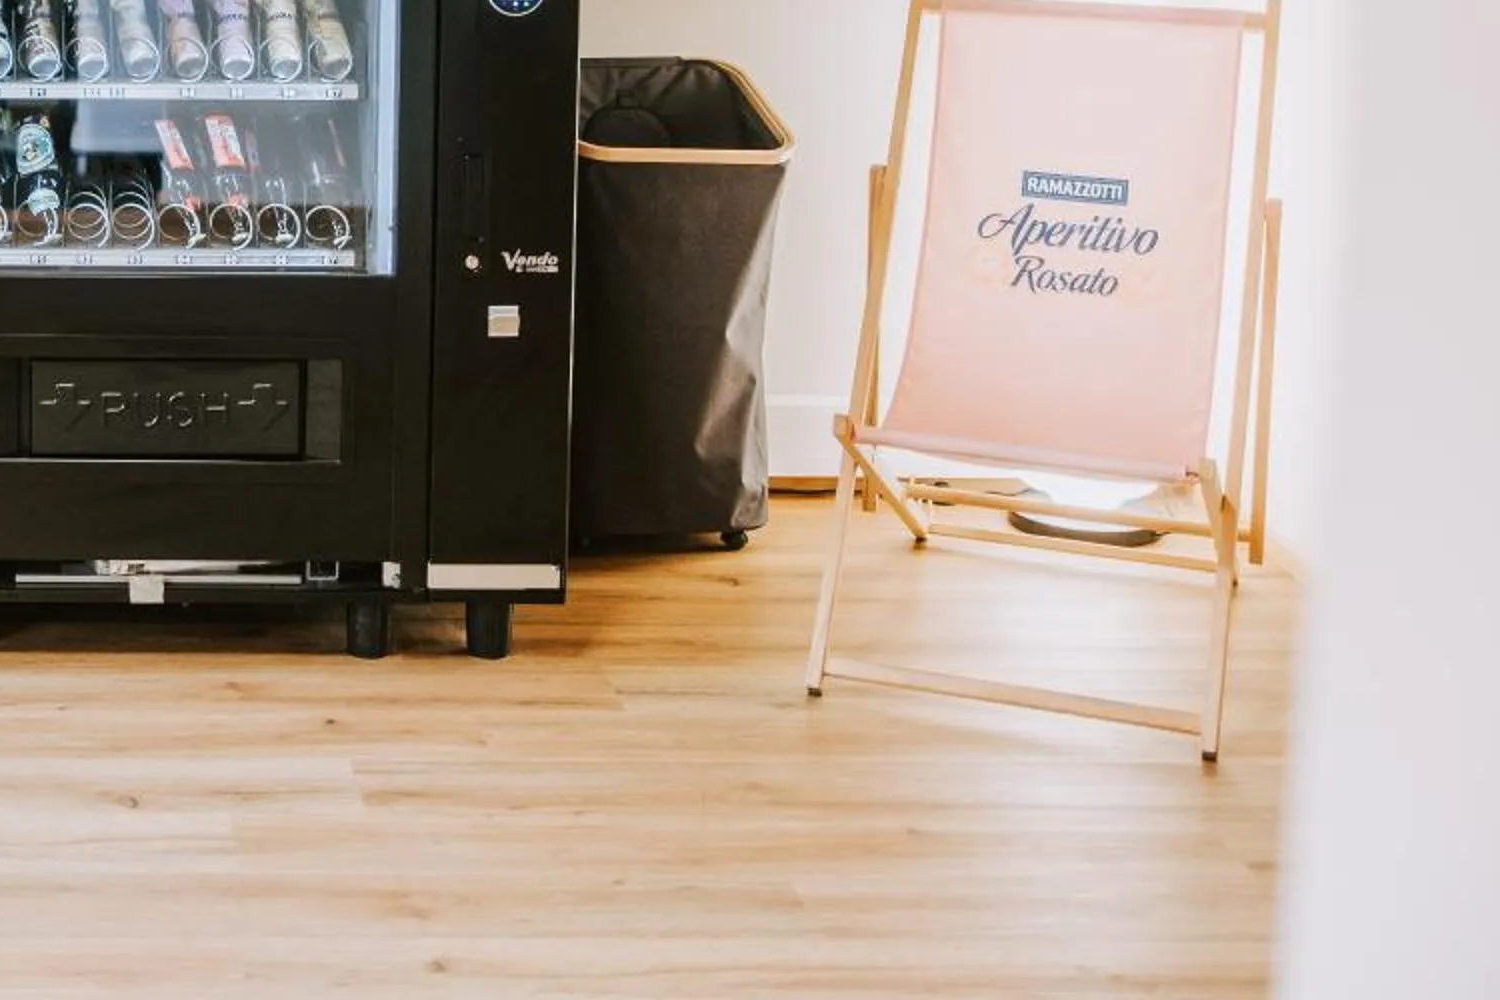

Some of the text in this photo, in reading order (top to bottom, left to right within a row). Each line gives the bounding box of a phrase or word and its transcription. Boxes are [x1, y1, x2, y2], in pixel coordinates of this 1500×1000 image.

[1026, 176, 1122, 200] RAMAZZOTTI
[977, 203, 1159, 256] Aperitivo
[500, 248, 559, 271] Vendo
[1011, 255, 1119, 296] Rosato
[100, 391, 229, 427] PUSH
